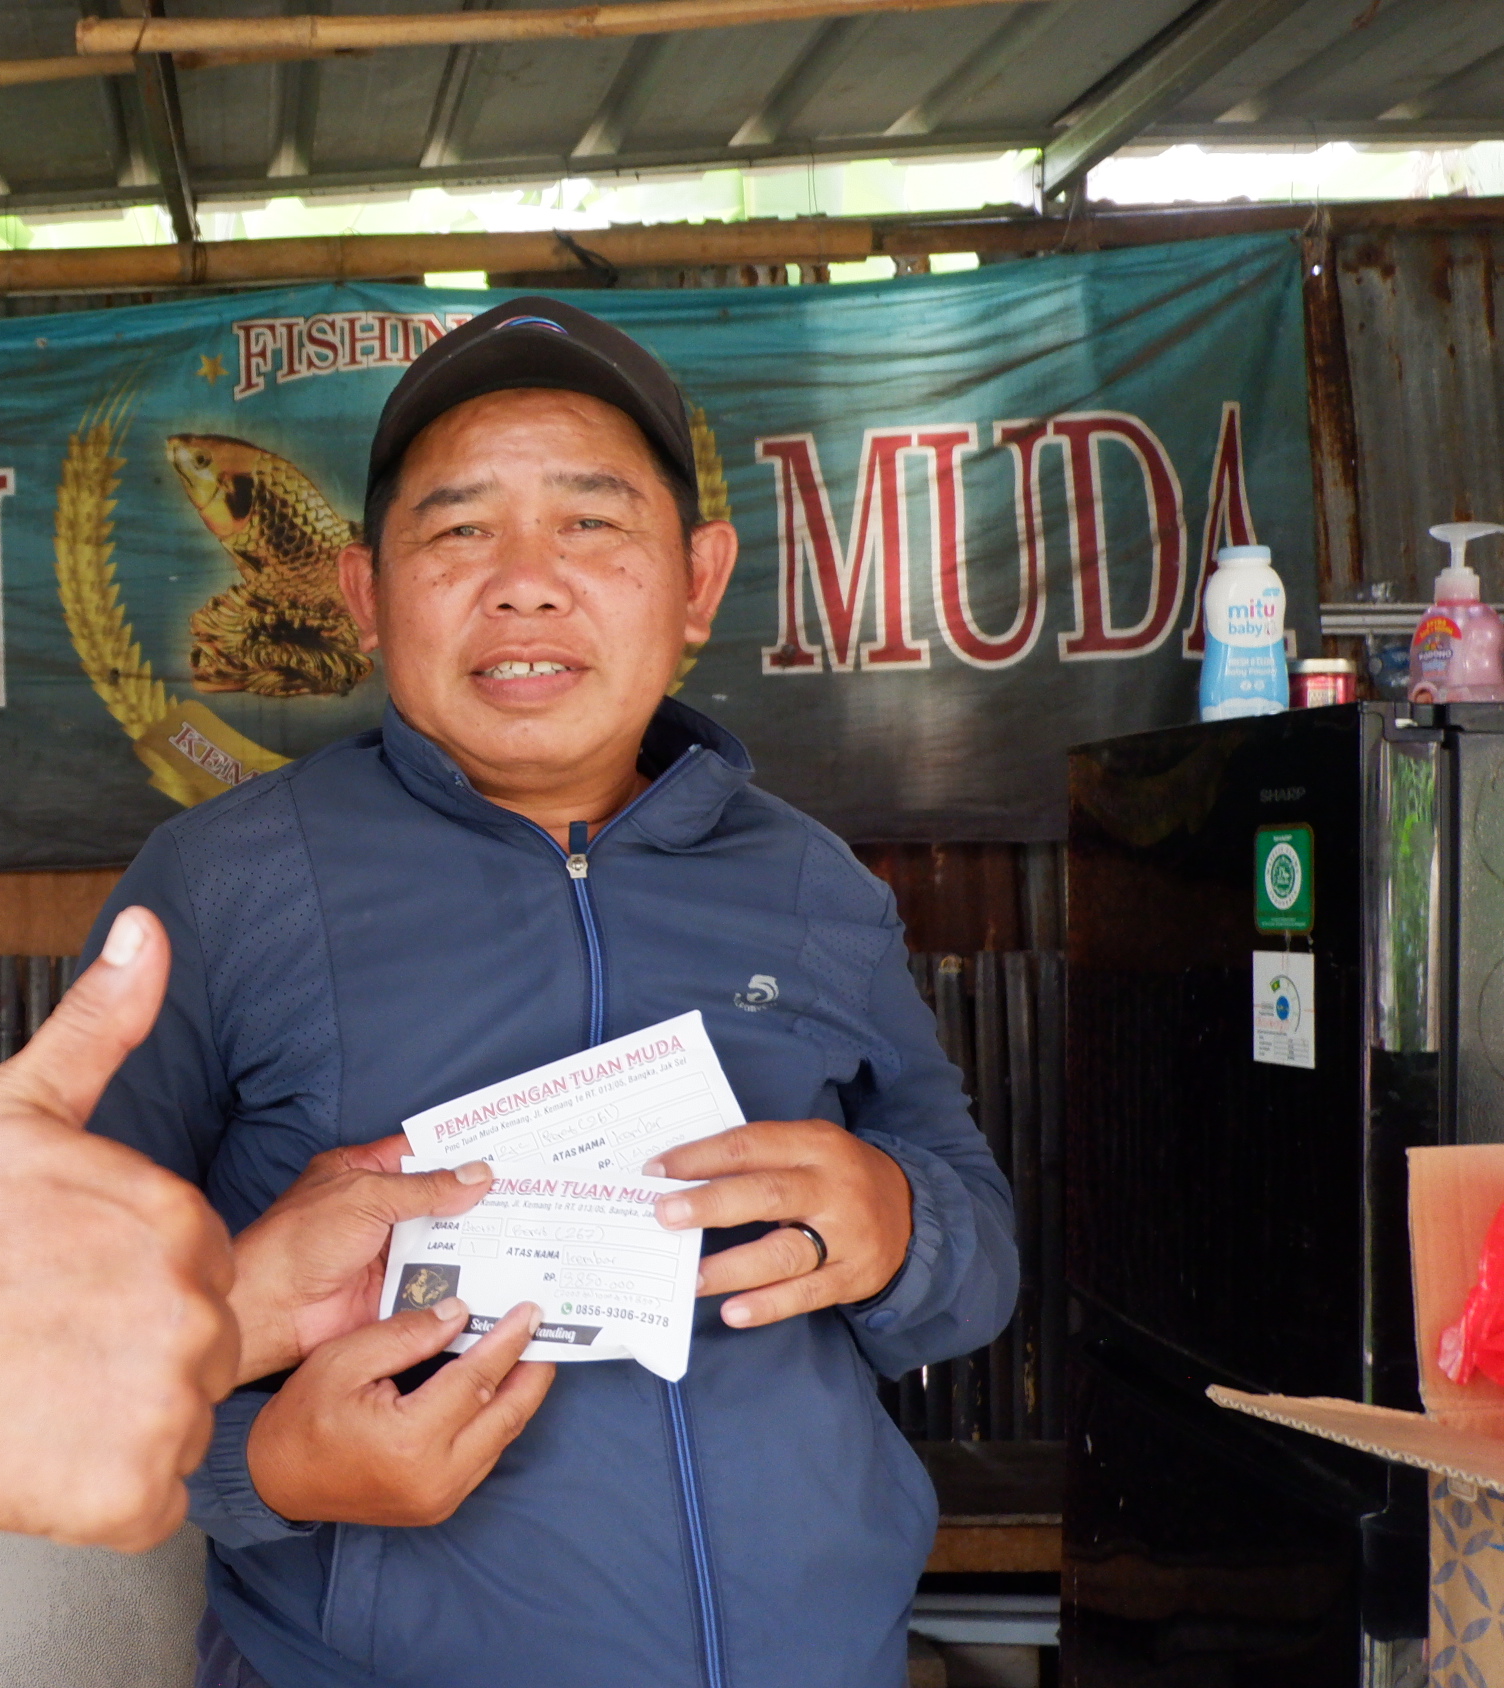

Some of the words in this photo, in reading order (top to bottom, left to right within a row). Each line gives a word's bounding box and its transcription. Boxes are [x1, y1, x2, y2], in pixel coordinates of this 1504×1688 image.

[1227, 598, 1276, 619] mitu
[1227, 621, 1263, 638] baby
[1259, 785, 1306, 803] SHARP
[433, 1075, 569, 1143] PEMANCINGAN
[569, 1056, 624, 1089] TUAN
[625, 1034, 686, 1070] MUDA
[461, 1134, 479, 1149] Tuan
[479, 1125, 500, 1140] Muda
[543, 1097, 574, 1115] Kemang
[659, 1060, 674, 1073] Jak
[674, 1056, 688, 1069] Sel
[552, 1146, 580, 1163] ATAS
[579, 1137, 606, 1154] NAMA
[597, 1158, 614, 1171] RP.
[559, 1180, 614, 1203] TUAN
[522, 1200, 552, 1211] Kemang
[431, 1221, 460, 1231] JUARA
[427, 1241, 456, 1251] LAPAK
[506, 1246, 533, 1258] ATAS
[533, 1248, 560, 1260] NAMA
[542, 1272, 558, 1282] RP.
[575, 1304, 670, 1328] 0856-9306-2978
